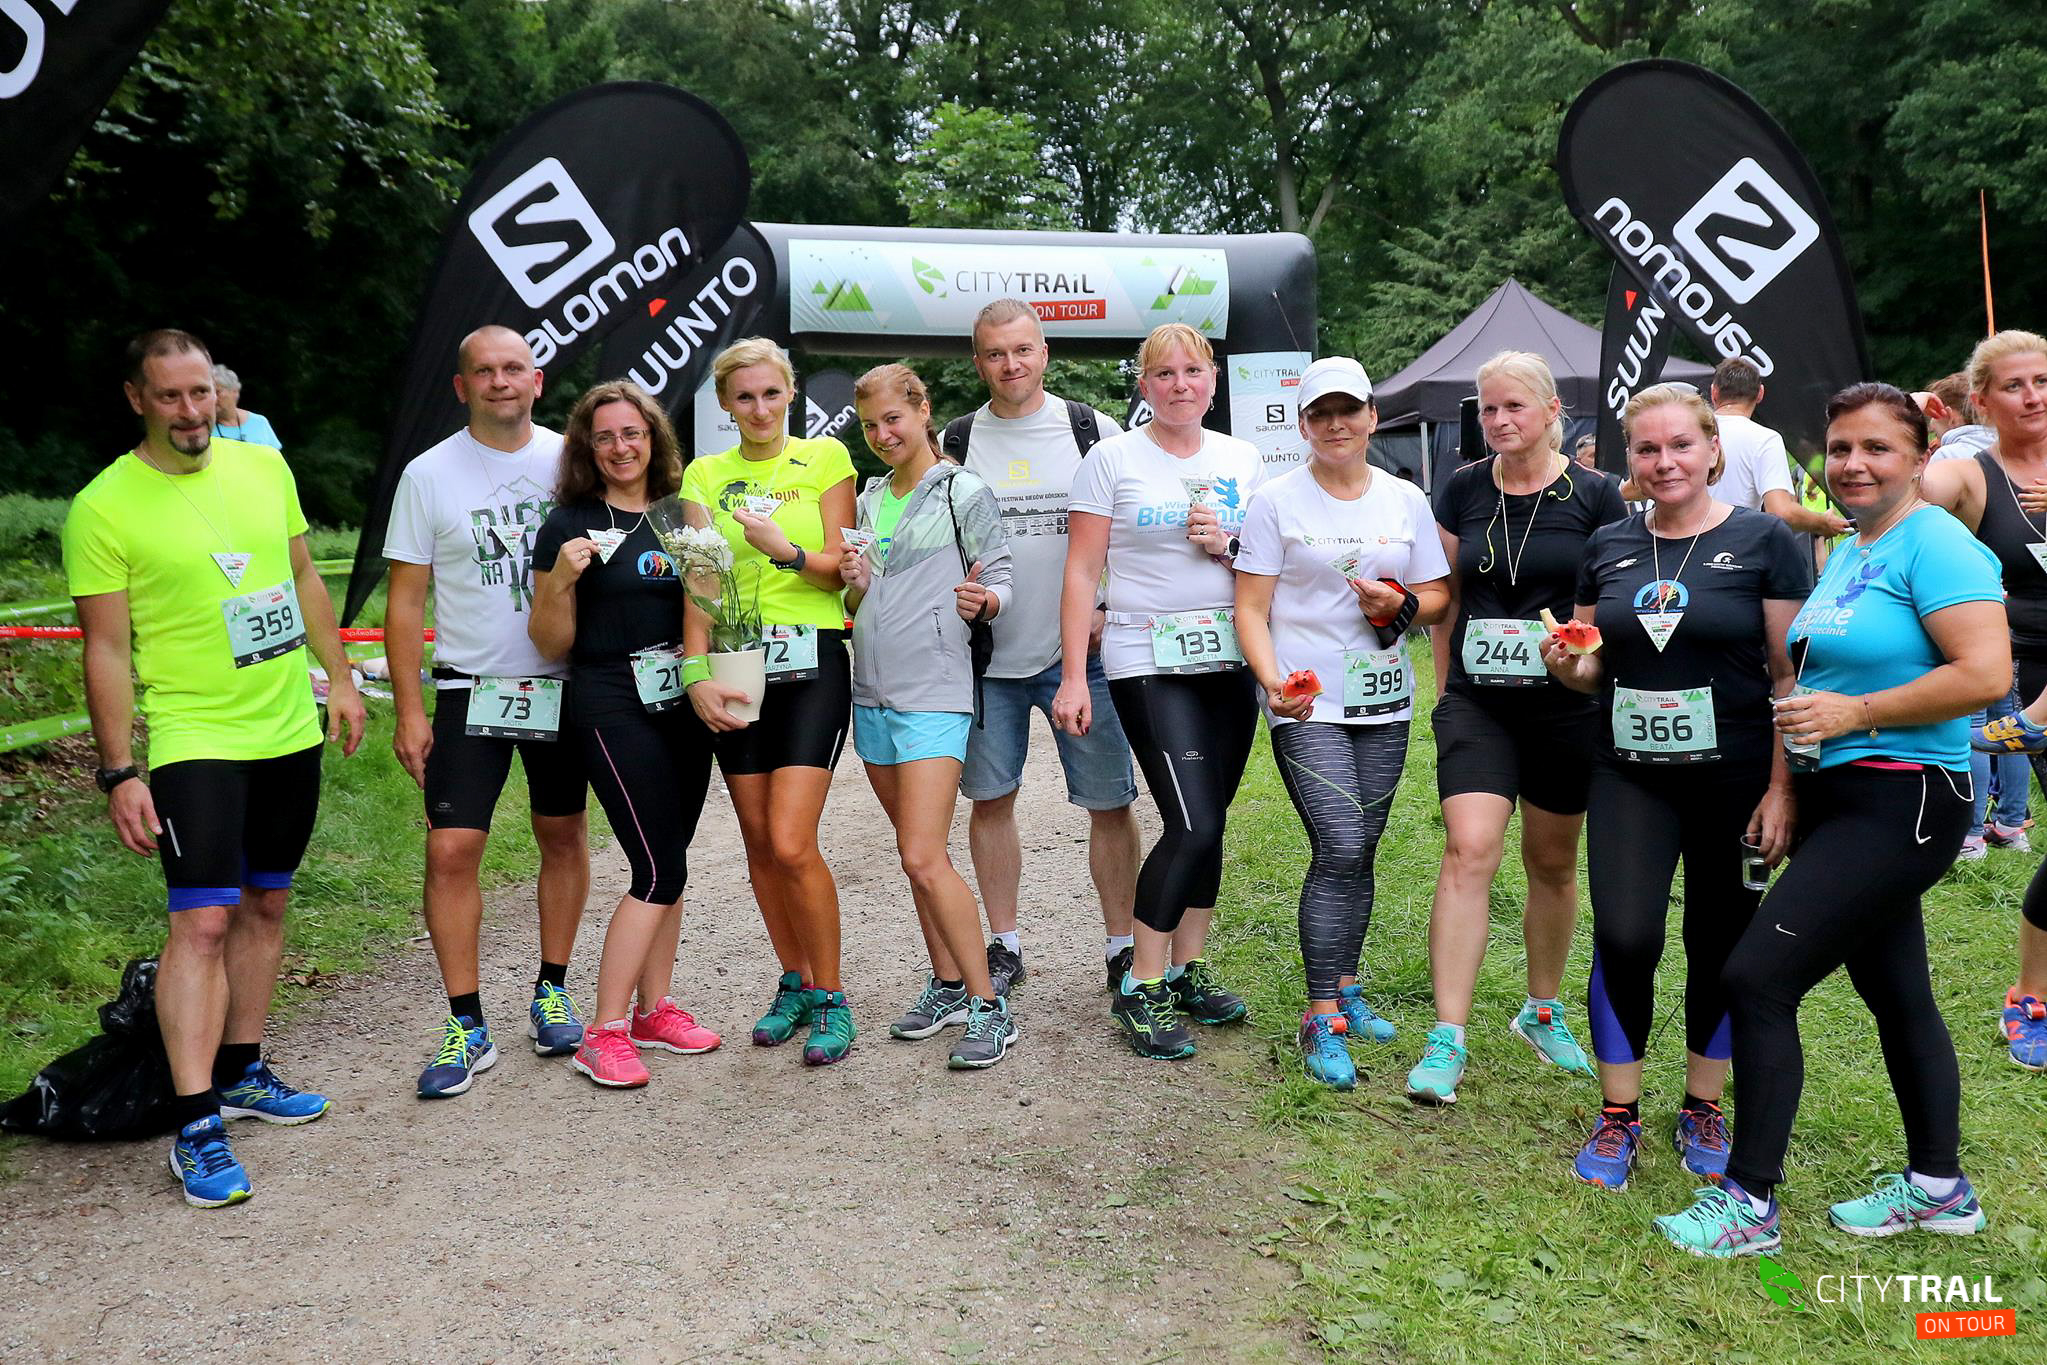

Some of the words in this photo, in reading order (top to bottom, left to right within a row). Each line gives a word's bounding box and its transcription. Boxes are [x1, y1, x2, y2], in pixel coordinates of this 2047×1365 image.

[1036, 305, 1055, 318] ON
[1060, 303, 1098, 317] TOUR
[628, 256, 757, 396] UUNTO
[1608, 296, 1665, 419] SUUN
[1262, 452, 1300, 463] UUNTO
[776, 489, 800, 502] RUN
[247, 605, 294, 642] 359
[1175, 630, 1222, 656] 133
[1475, 640, 1530, 666] 244
[765, 663, 793, 672] TARZYNA
[1362, 668, 1402, 697] 399
[498, 695, 532, 720] 73
[1630, 714, 1693, 742] 366
[1650, 743, 1674, 751] BEATA
